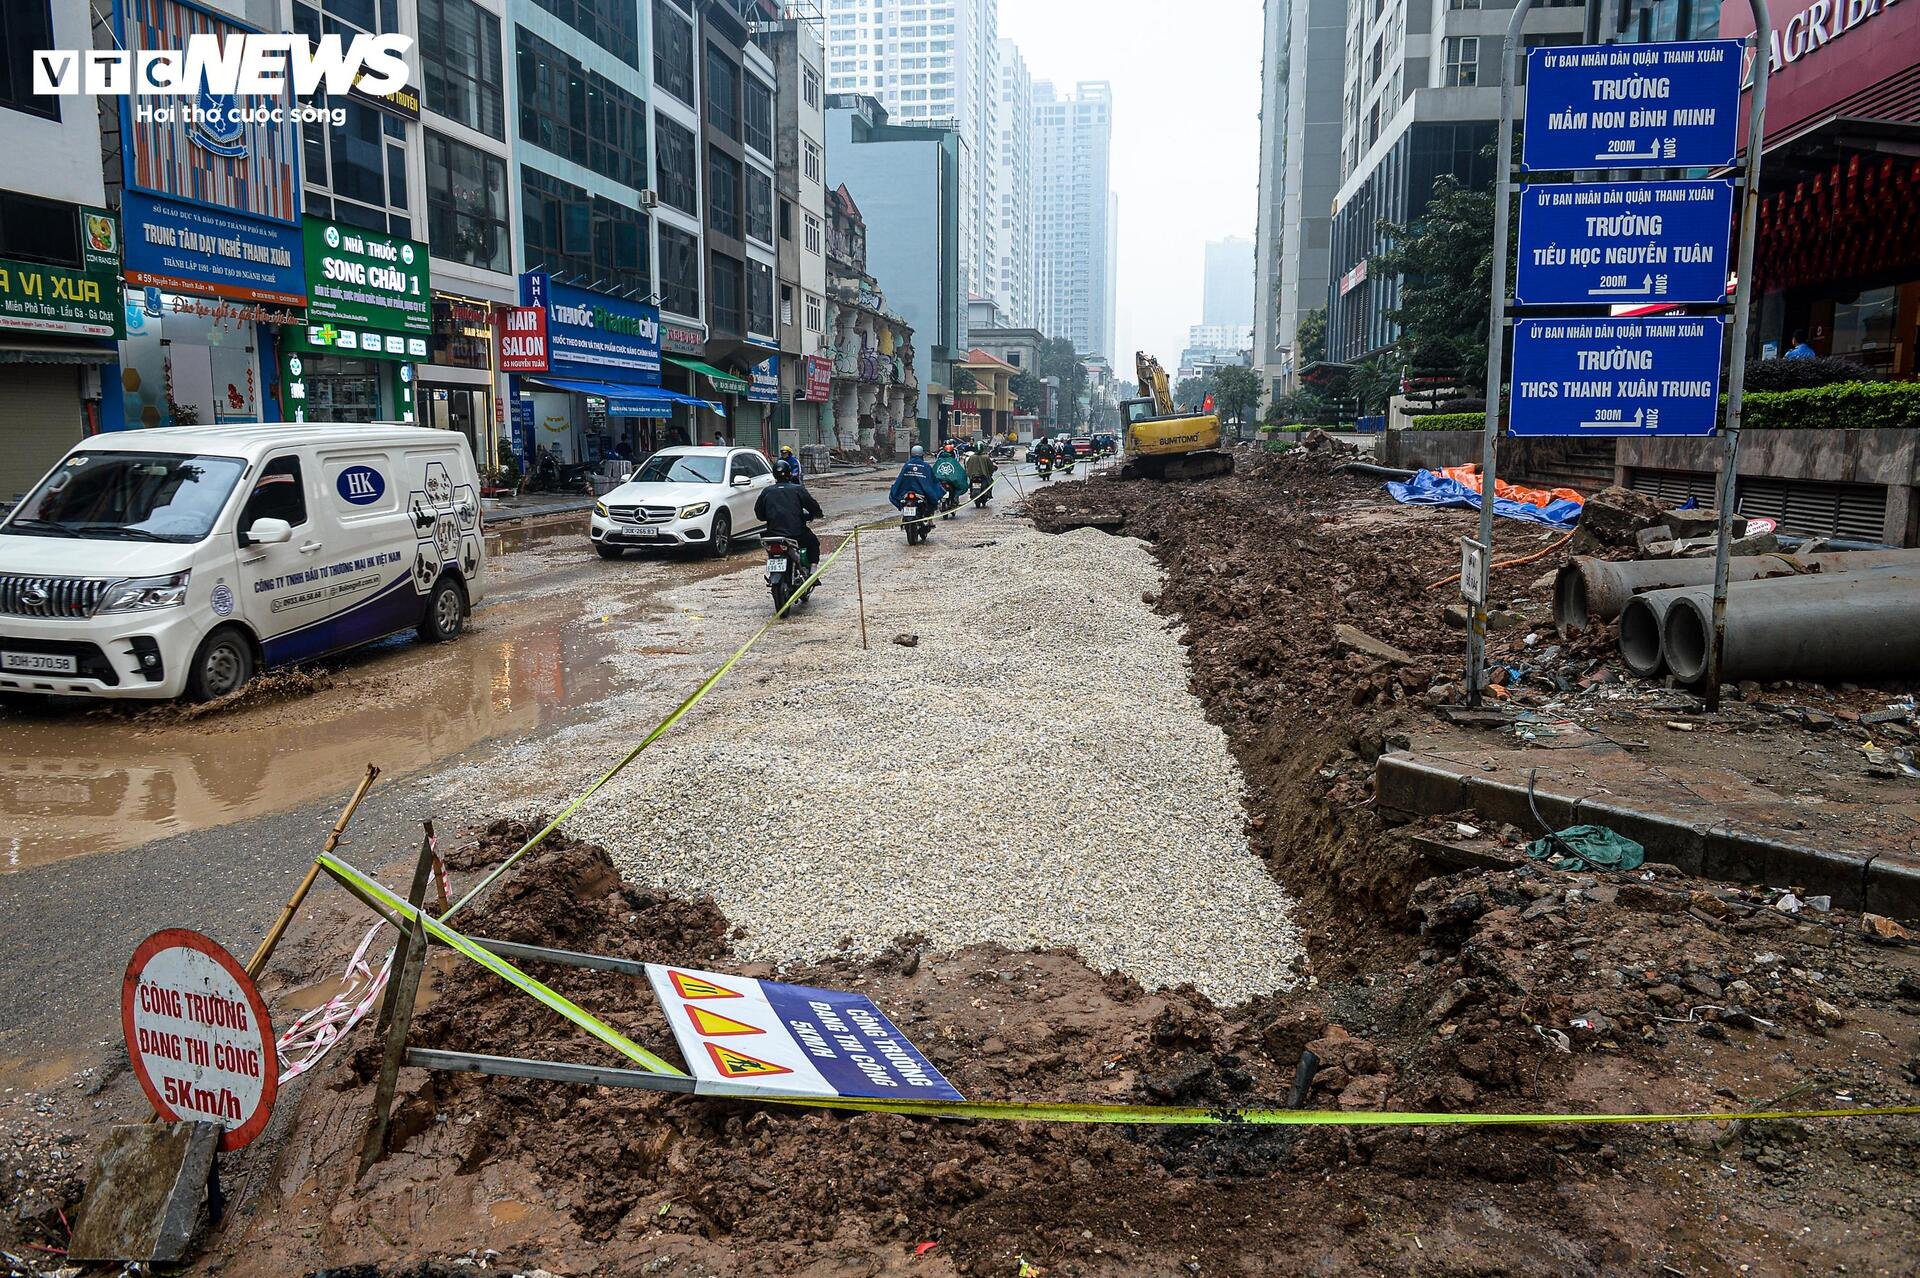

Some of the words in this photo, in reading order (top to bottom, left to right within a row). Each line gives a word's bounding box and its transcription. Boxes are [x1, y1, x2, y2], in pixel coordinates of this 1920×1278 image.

[1545, 51, 1557, 68] ỦY
[1559, 55, 1580, 67] BAN
[1581, 51, 1608, 67] NHÂN
[1610, 50, 1630, 66] DÂN
[1633, 50, 1659, 69] QUẬN
[1663, 51, 1694, 64] THANH
[1697, 47, 1724, 63] XUÂN
[1592, 72, 1670, 101] TRƯỜNG
[1549, 105, 1588, 130] MẦM
[1592, 112, 1625, 129] NON
[1630, 107, 1667, 128] BÌNH
[1673, 108, 1716, 126] MINH
[1608, 140, 1635, 152] 200M
[1663, 137, 1676, 159] 30M
[1538, 190, 1550, 206] ỦY
[1553, 194, 1572, 205] BAN
[1575, 190, 1601, 204] NHÂN
[1604, 189, 1623, 204] DÂN
[1625, 188, 1651, 205] QUẬN
[1655, 189, 1686, 202] THANH
[1688, 187, 1714, 201] XUÂN
[1586, 211, 1662, 237] TRƯỜNG
[143, 223, 176, 247] TRUNG
[178, 227, 198, 251] TÂM
[199, 235, 216, 258] DẠY
[243, 242, 270, 264] THANH
[270, 246, 291, 268] XUÂN
[343, 235, 365, 255] NHÀ
[366, 240, 398, 262] THUỐC
[1533, 242, 1566, 266] TIỂU
[1570, 249, 1601, 268] HỌC
[1605, 241, 1667, 264] NGUYỄN
[1673, 243, 1713, 263] TUÂN
[18, 271, 43, 300] VỊ
[143, 274, 152, 283] 59
[322, 257, 366, 285] SONG
[367, 265, 406, 293] CHÂU
[410, 275, 420, 296] 1
[1600, 275, 1627, 288] 200M
[1655, 274, 1668, 295] 30M
[507, 311, 537, 331] HAIR
[555, 303, 594, 328] THUỐC
[593, 305, 659, 344] Pharmacity
[1531, 323, 1543, 339] ỦY
[1545, 327, 1564, 338] BAN
[1566, 324, 1592, 338] NHÂN
[1594, 324, 1614, 338] DÂN
[1617, 323, 1642, 340] QUẬN
[1645, 325, 1676, 337] THANH
[1678, 323, 1704, 337] XUÂN
[502, 336, 544, 357] SALON
[1577, 345, 1653, 371] TRƯỜNG
[503, 360, 510, 368] 63
[1520, 381, 1559, 398] THCS
[1563, 381, 1612, 398] THANH
[1616, 378, 1658, 397] XUÂN
[1661, 380, 1712, 397] TRUNG
[1594, 408, 1622, 421] 300M
[1646, 408, 1659, 429] 20M
[1159, 434, 1199, 446] SUMITOMO
[346, 472, 377, 495] HK
[254, 578, 275, 594] CÔNG
[276, 577, 285, 589] TY
[284, 571, 305, 587] TNHH
[354, 559, 367, 572] MẠI
[366, 556, 376, 568] HK
[376, 552, 388, 567] VIỆT
[388, 551, 402, 563] NAM
[140, 981, 183, 1019] CÔNG
[184, 990, 249, 1032] TRƯỜNG
[808, 1000, 850, 1033] ĐANG
[789, 1020, 838, 1059] 5KM/H
[833, 1034, 868, 1053] THI
[846, 1008, 889, 1038] CÔNG
[872, 1039, 934, 1087] TRƯỜNG
[139, 1027, 182, 1062] ĐANG
[184, 1037, 210, 1068] THI
[214, 1039, 260, 1078] CÔNG
[850, 1054, 899, 1087] CÔNG
[164, 1076, 242, 1121] 5Km/h
